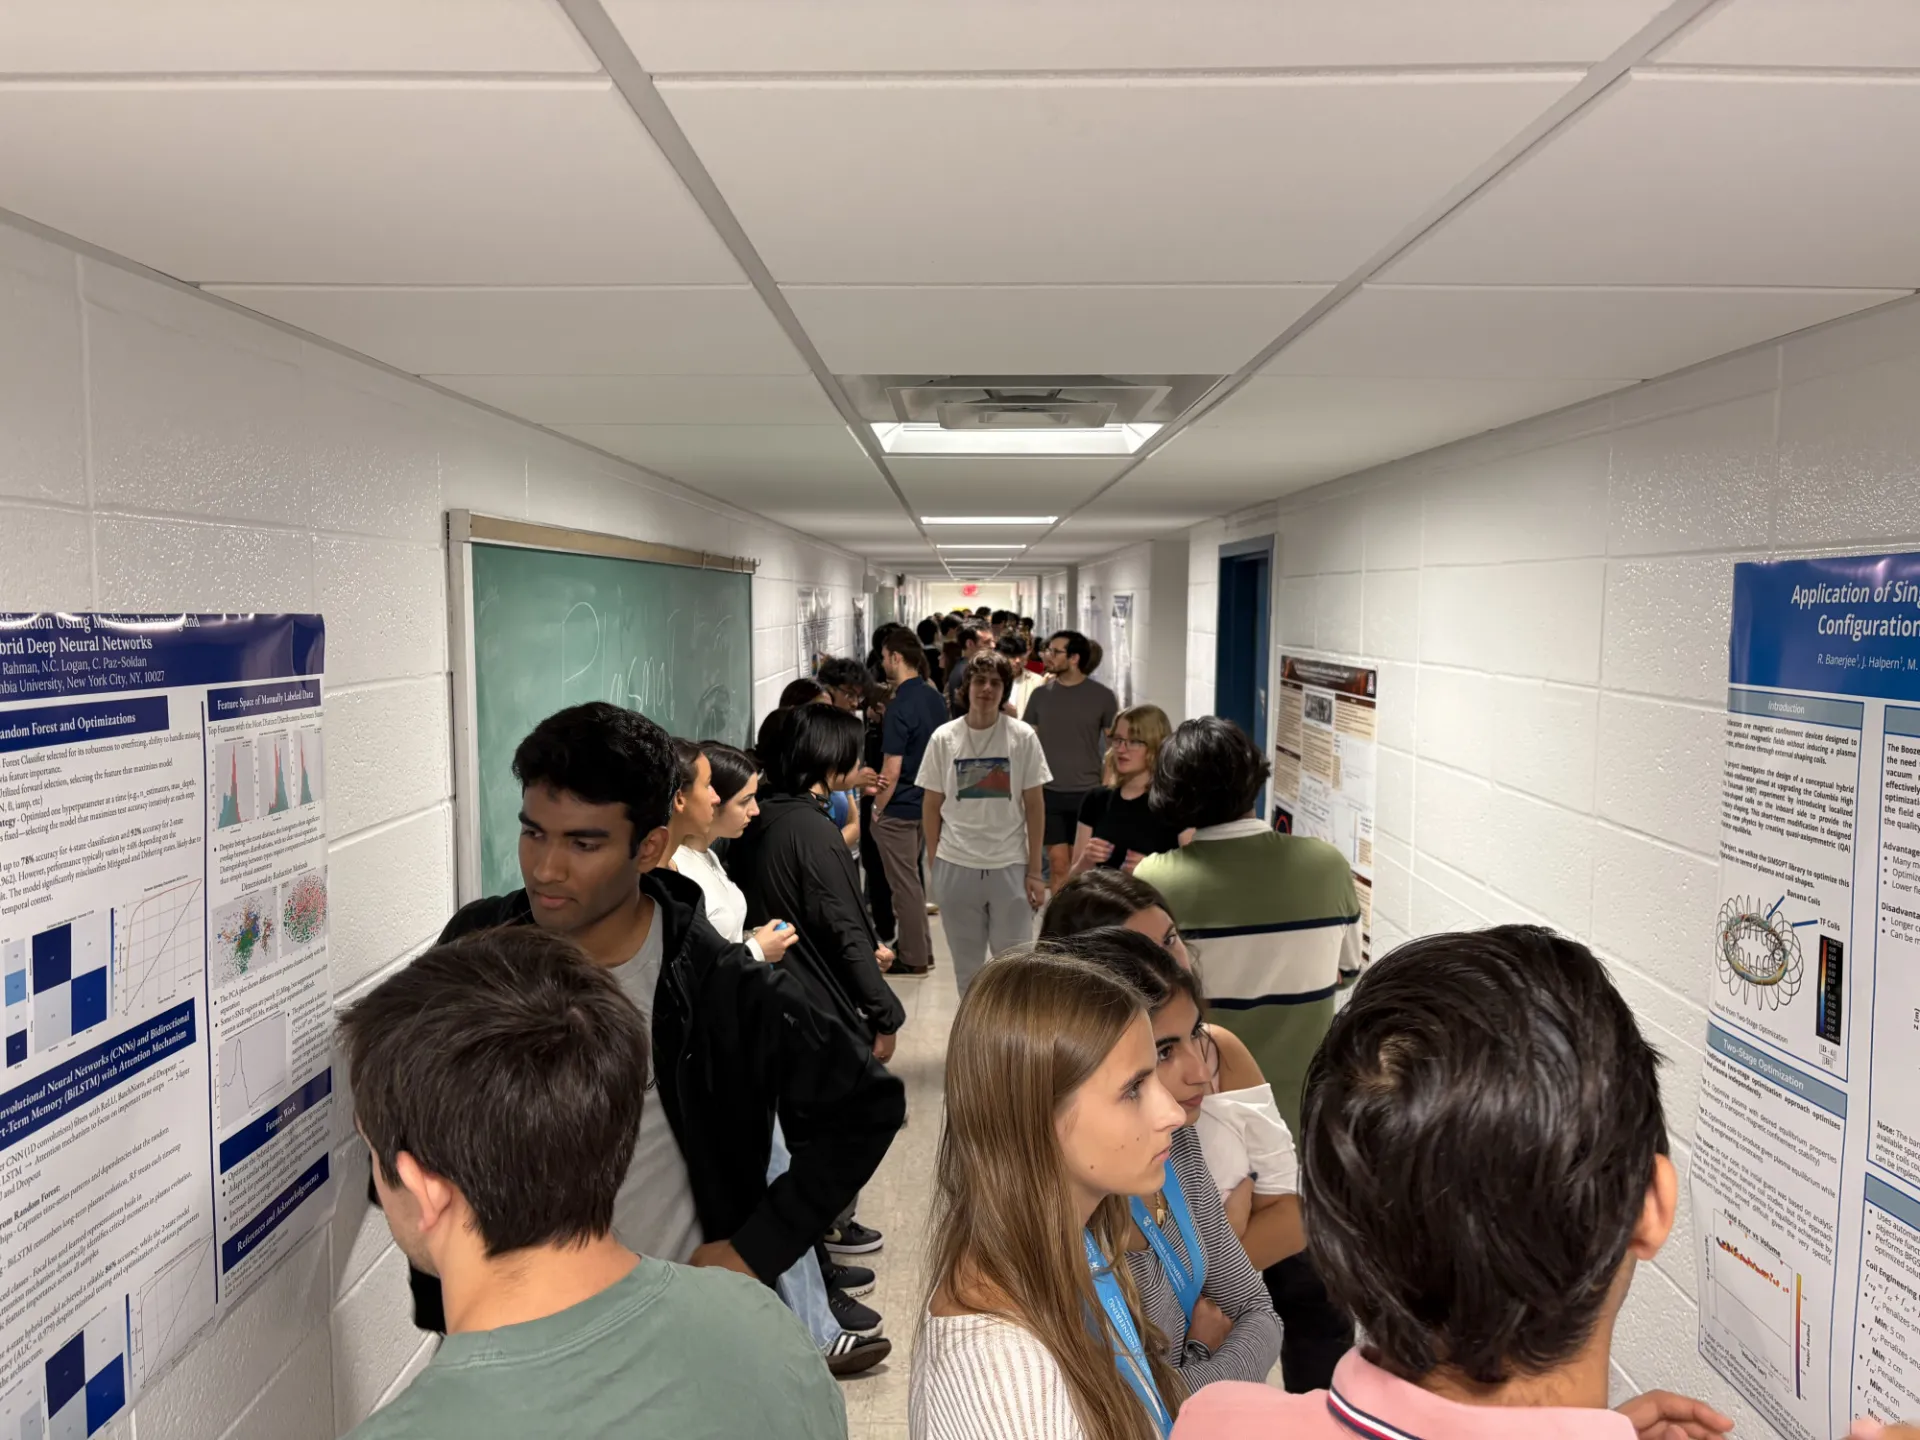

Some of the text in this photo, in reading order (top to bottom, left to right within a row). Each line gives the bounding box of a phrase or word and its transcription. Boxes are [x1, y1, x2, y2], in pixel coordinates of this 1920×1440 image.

[1791, 582, 1870, 610] Application
[1873, 580, 1893, 603] of
[184, 614, 200, 628] and
[27, 637, 56, 658] Deep
[59, 635, 99, 653] Neural
[102, 634, 152, 652] Networks
[2, 656, 147, 675] Rahman, N.C. Logan, C. Paz-Soldan
[1817, 653, 1824, 665] R.
[1907, 658, 1918, 671] M.
[20, 677, 65, 692] University,
[67, 676, 86, 689] New
[88, 674, 108, 687] York
[109, 672, 128, 689] City,
[129, 672, 143, 685] NY,
[144, 670, 165, 683] 10027
[217, 689, 314, 711] Feature Space of Manually Labeled Data
[1767, 701, 1805, 714] Introduction
[31, 722, 58, 736] Forest
[60, 717, 76, 732] and
[77, 713, 136, 733] Optimizations
[1752, 723, 1858, 746] magnetic confinement devices designed to
[1786, 738, 1857, 758] without inducing plasma
[1887, 743, 1900, 752] The
[2, 758, 20, 769] Forest
[1794, 751, 1813, 765] shaping
[1886, 755, 1917, 768] the need
[29, 766, 63, 780] importance.
[1885, 769, 1913, 779] vacuum
[44, 778, 69, 791] selection,
[1805, 777, 1855, 794] conceptual hybrid
[1885, 780, 1920, 796] effectively
[62, 797, 105, 816] hyperparameter
[1802, 787, 1854, 807] the Columbia High
[1796, 797, 1854, 818] introducing localized
[1884, 805, 1914, 818] the field
[59, 815, 77, 827] model
[1760, 810, 1852, 841] short-term modification designed
[1796, 809, 1853, 829] side provide the
[1884, 817, 1920, 833] the quality
[1785, 829, 1851, 854] quasi-axisymmetric (QA)
[18, 859, 82, 882] However, performance
[20, 855, 35, 867] 78%
[1892, 856, 1912, 869] Many
[1767, 855, 1850, 888] SIMSOPT library optimize this
[8, 886, 22, 899] The
[1794, 876, 1815, 889] shapes.
[1891, 880, 1913, 894] Lower
[1, 893, 54, 915] temporal context.
[1786, 889, 1822, 907] Banana Coils
[1819, 917, 1841, 932] TF Coils
[1890, 916, 1915, 932] Longer
[1889, 928, 1914, 943] Can be
[0, 1010, 190, 1120] nvolutional Neural Networks (CNNs) and Bidirectional
[1723, 1037, 1805, 1091] Two-Stage Optimization
[31, 1096, 64, 1122] Memory
[63, 1073, 101, 1105] (BiLSTM)
[101, 1065, 118, 1082] with
[118, 1049, 151, 1073] Attention
[151, 1030, 187, 1055] Mechanism
[1751, 1077, 1841, 1131] optimization approach optimizes
[265, 1102, 297, 1133] Future Work
[1876, 1119, 1908, 1143] Note: The
[1876, 1131, 1904, 1151] available
[1875, 1153, 1896, 1170] can be
[1876, 1142, 1910, 1167] where coils
[1876, 1211, 1892, 1227] Uses
[236, 1220, 266, 1253] References
[265, 1210, 276, 1227] and
[1723, 1208, 1738, 1224] Field
[1738, 1218, 1752, 1234] Error
[1760, 1235, 1781, 1258] Volume
[1875, 1223, 1904, 1245] objective
[1875, 1232, 1904, 1257] Performs
[1874, 1244, 1906, 1269] optimized
[1865, 1258, 1918, 1301] Coil Engineering
[1874, 1315, 1889, 1331] Min:
[1895, 1330, 1907, 1344] cm
[1871, 1346, 1886, 1363] Min:
[1892, 1362, 1904, 1376] cm
[1869, 1378, 1884, 1394] Min:
[1889, 1394, 1901, 1408] cm
